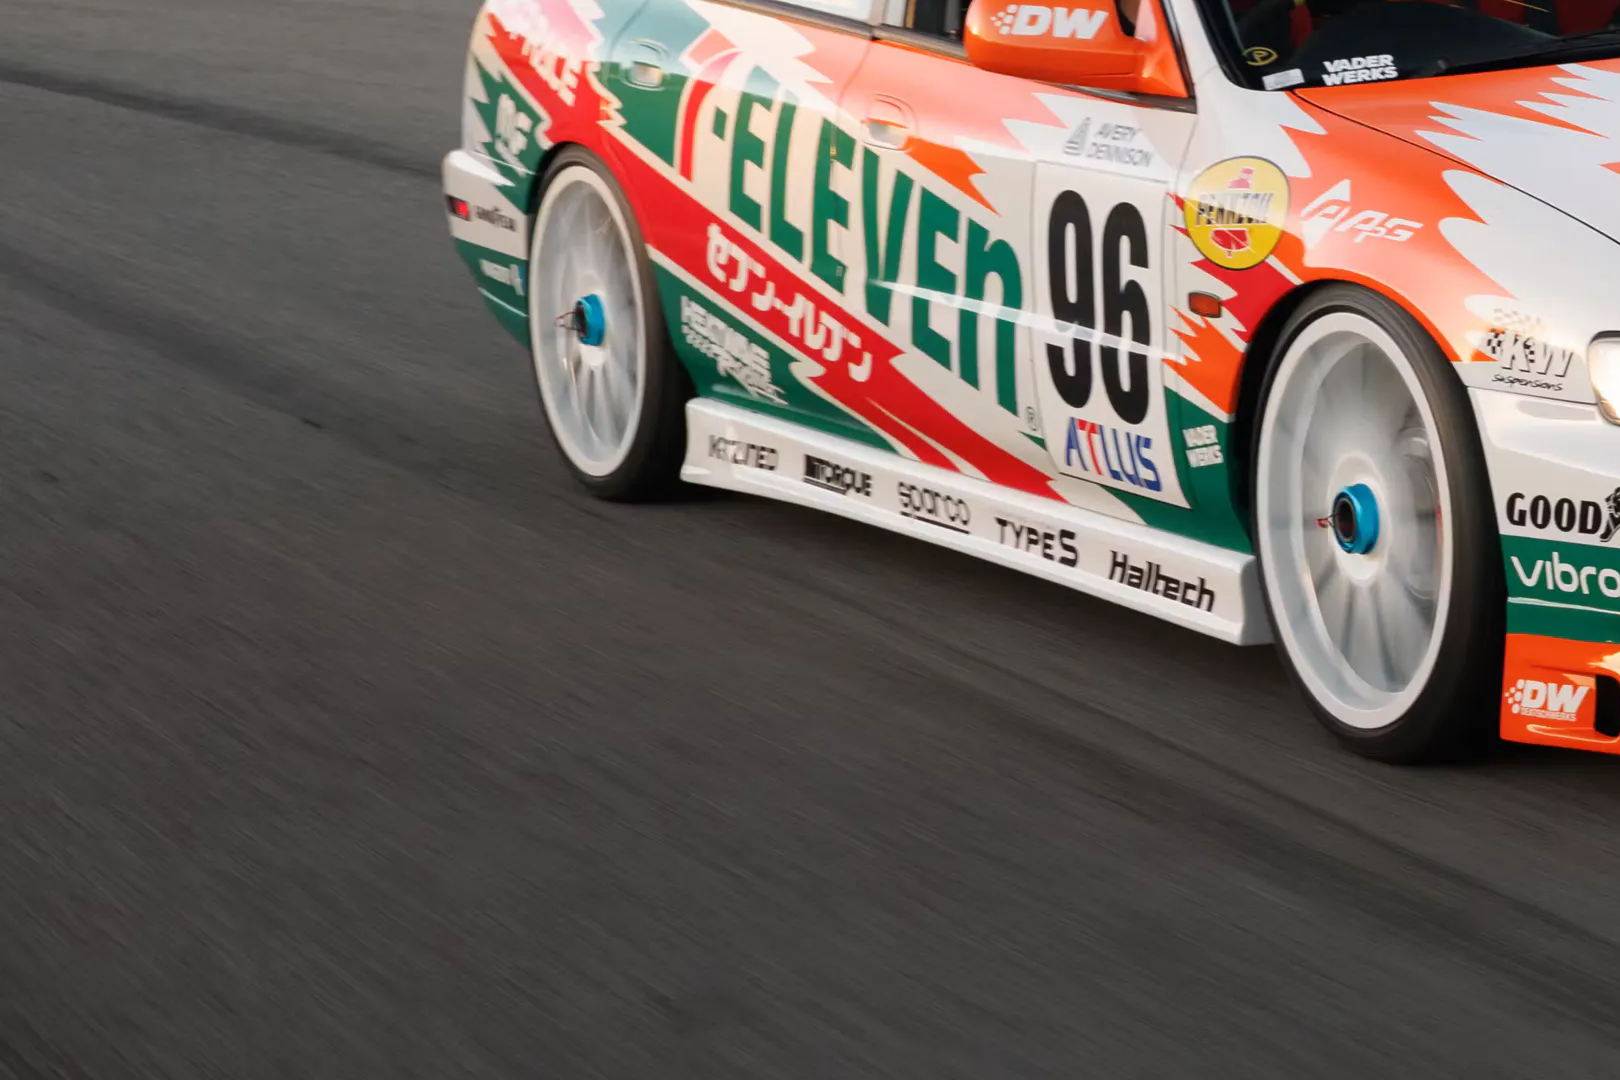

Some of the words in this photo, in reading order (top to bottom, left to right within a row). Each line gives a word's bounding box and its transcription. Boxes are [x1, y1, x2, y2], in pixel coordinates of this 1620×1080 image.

[1010, 5, 1109, 40] DW
[1321, 66, 1399, 87] WERKS
[1322, 54, 1395, 73] VADER
[1046, 189, 1151, 425] 96
[1066, 416, 1163, 493] ATLUS
[897, 481, 971, 526] sparco
[1108, 550, 1216, 613] Haltech
[1521, 679, 1590, 713] DW
